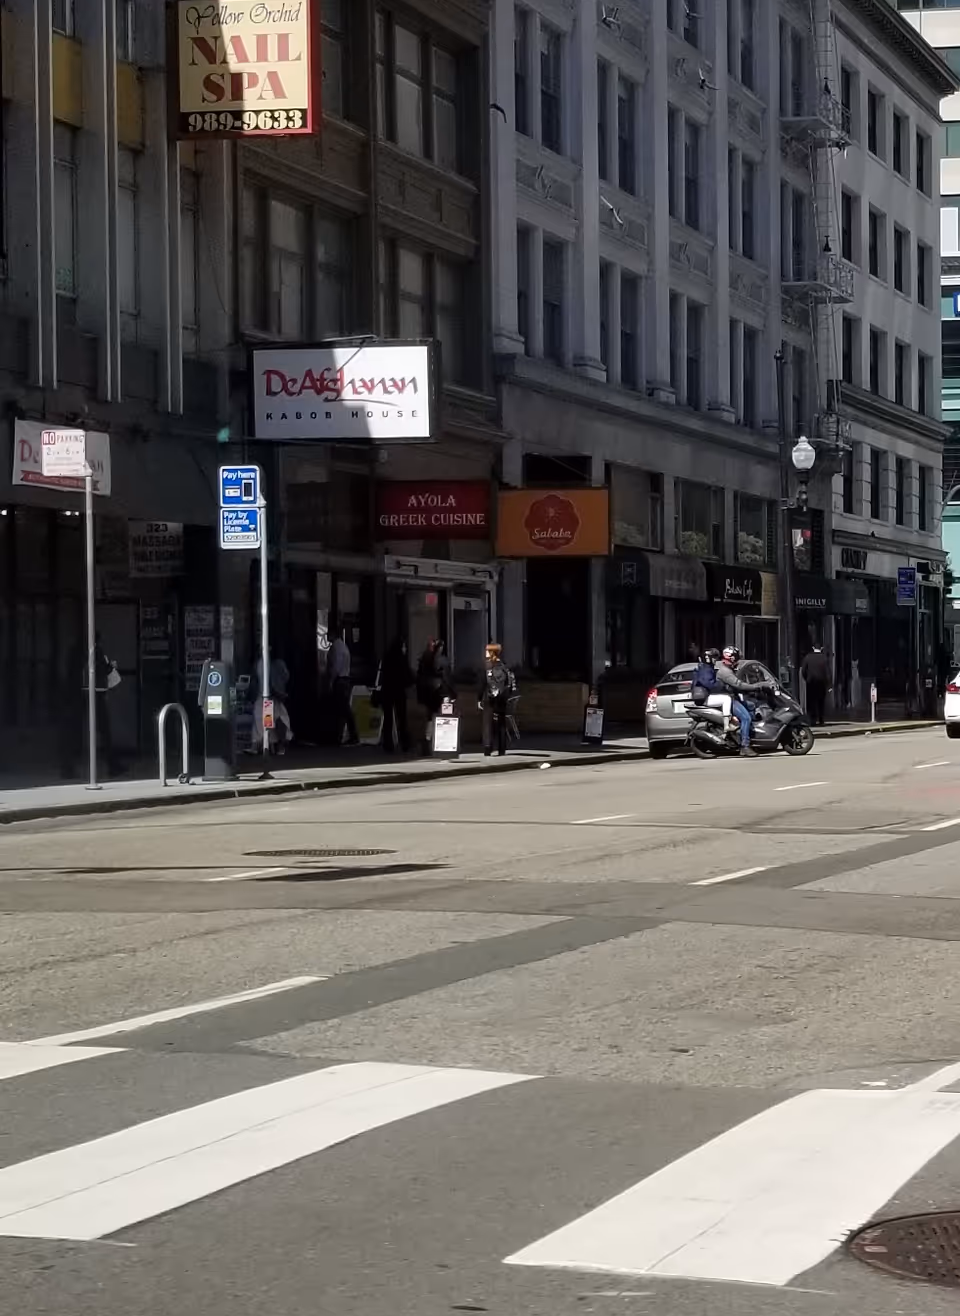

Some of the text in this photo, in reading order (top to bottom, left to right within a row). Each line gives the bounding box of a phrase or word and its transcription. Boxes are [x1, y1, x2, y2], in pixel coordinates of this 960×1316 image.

[186, 1, 302, 35] Yellow Orchid
[187, 32, 301, 66] NAIL
[201, 70, 289, 104] SPA
[188, 109, 303, 132] 989-9633
[266, 409, 419, 421] KABOB HOUSE
[223, 470, 255, 481] Pay here
[407, 494, 456, 507] AYOLA
[223, 511, 248, 520] Pay by
[379, 513, 485, 526] GREEK CUISINE
